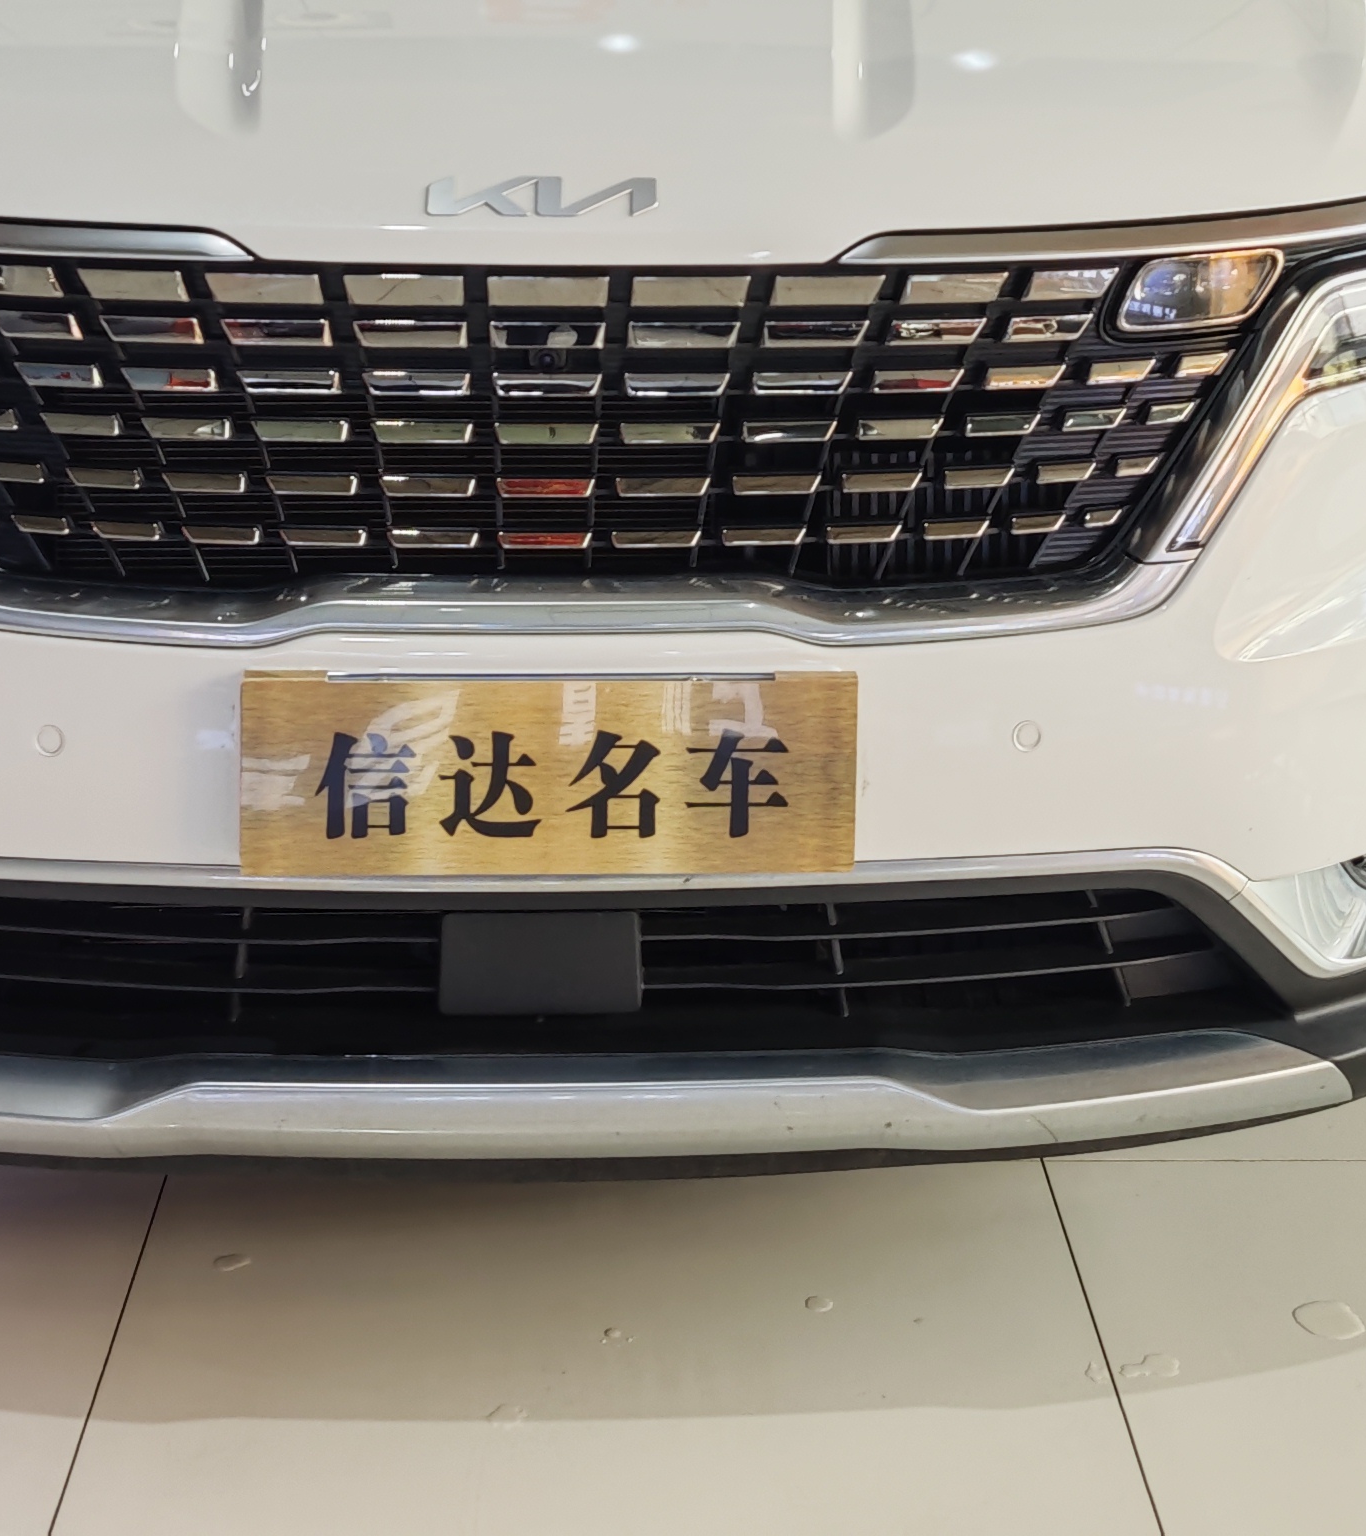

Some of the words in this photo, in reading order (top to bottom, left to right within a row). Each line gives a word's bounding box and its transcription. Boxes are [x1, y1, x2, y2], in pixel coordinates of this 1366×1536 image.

[426, 175, 659, 216] KIA
[314, 728, 790, 840] 信达名车
